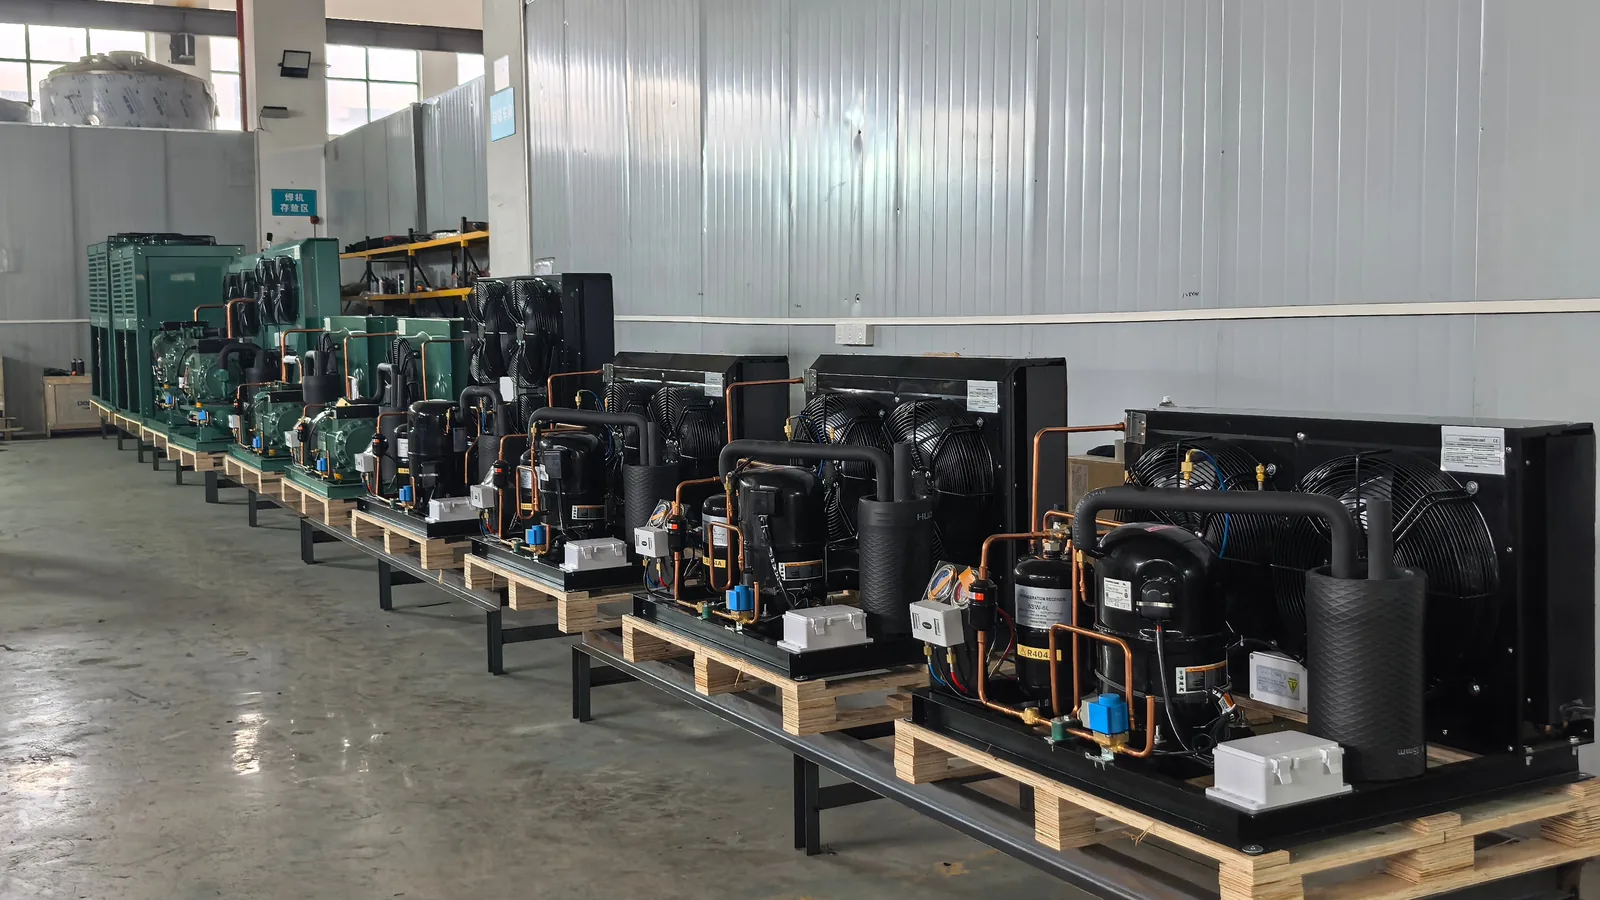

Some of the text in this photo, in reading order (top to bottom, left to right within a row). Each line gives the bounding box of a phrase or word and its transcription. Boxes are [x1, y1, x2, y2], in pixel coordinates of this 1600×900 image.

[280, 203, 309, 213] 存放区
[1027, 649, 1051, 659] R404
